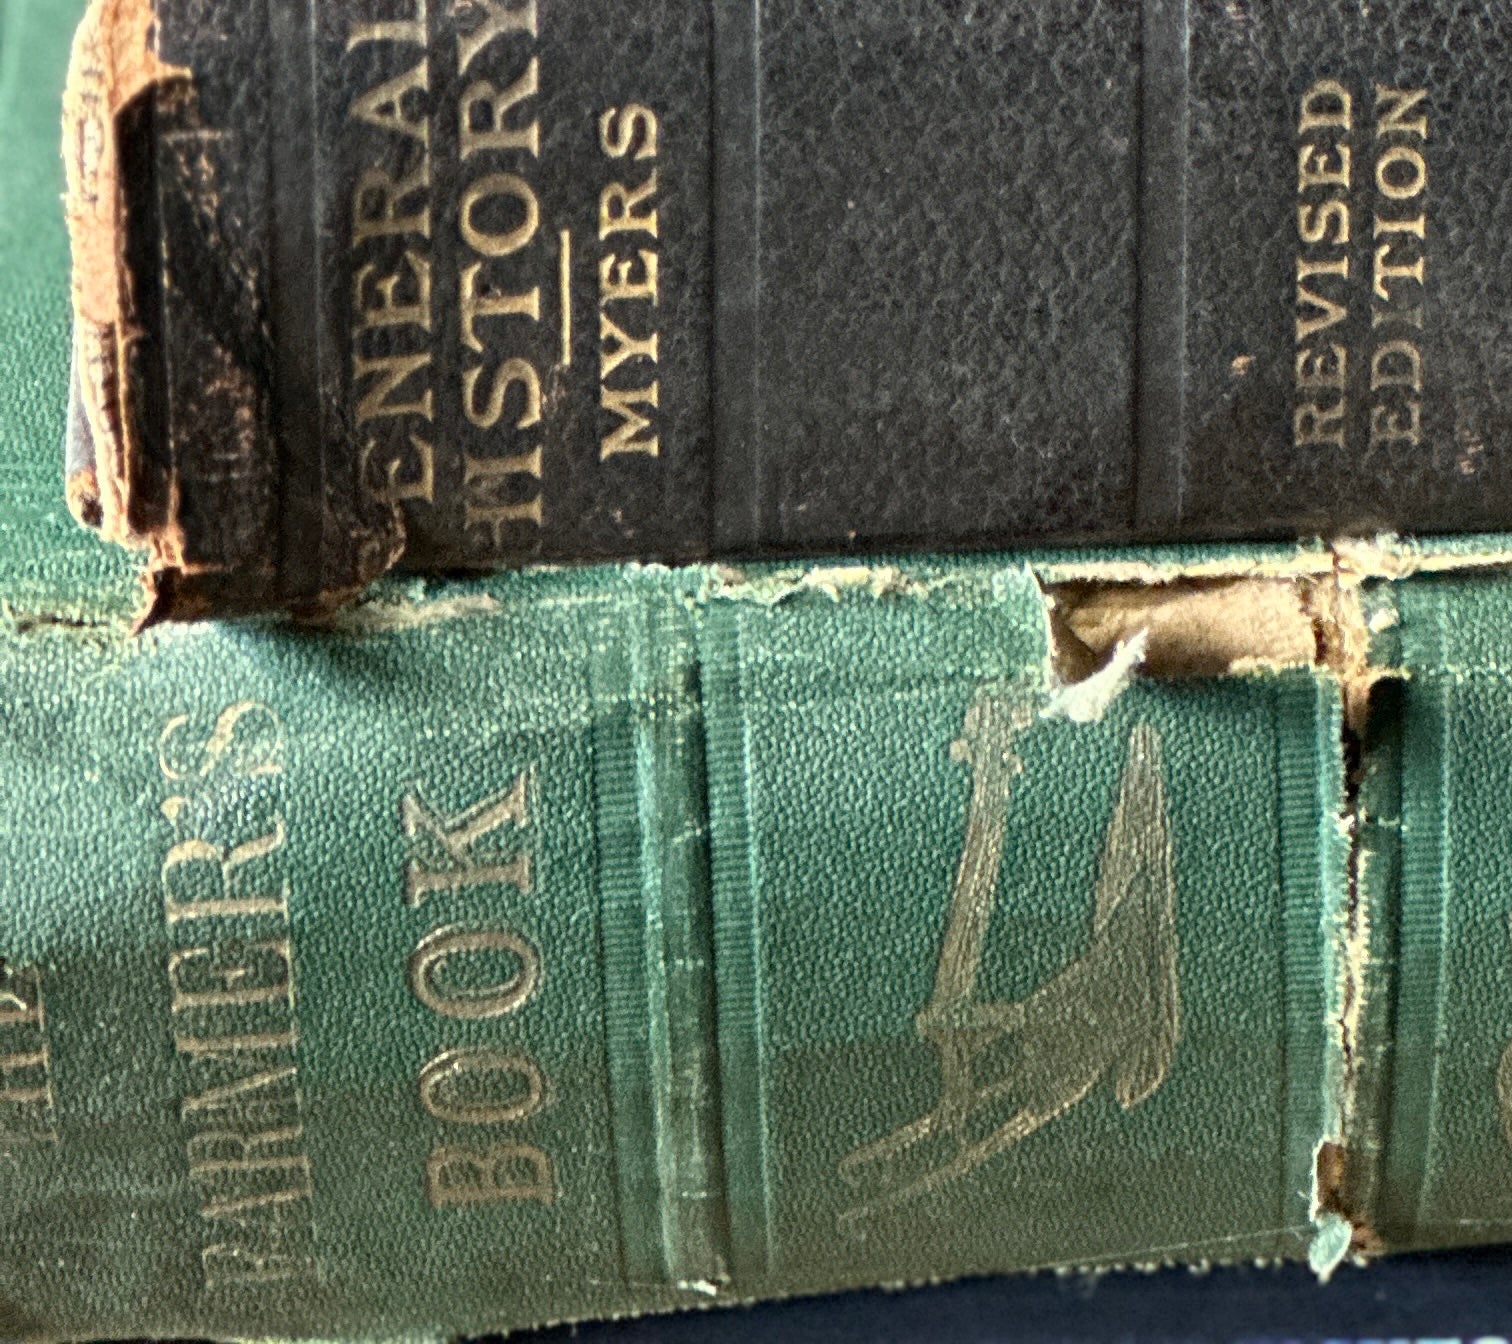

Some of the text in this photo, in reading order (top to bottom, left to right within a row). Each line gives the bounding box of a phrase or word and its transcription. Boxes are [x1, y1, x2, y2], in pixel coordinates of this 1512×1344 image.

[600, 102, 660, 461] MYERS
[1294, 78, 1353, 450] REVISED
[1370, 82, 1429, 448] EDITION
[401, 762, 562, 1209] BOOK
